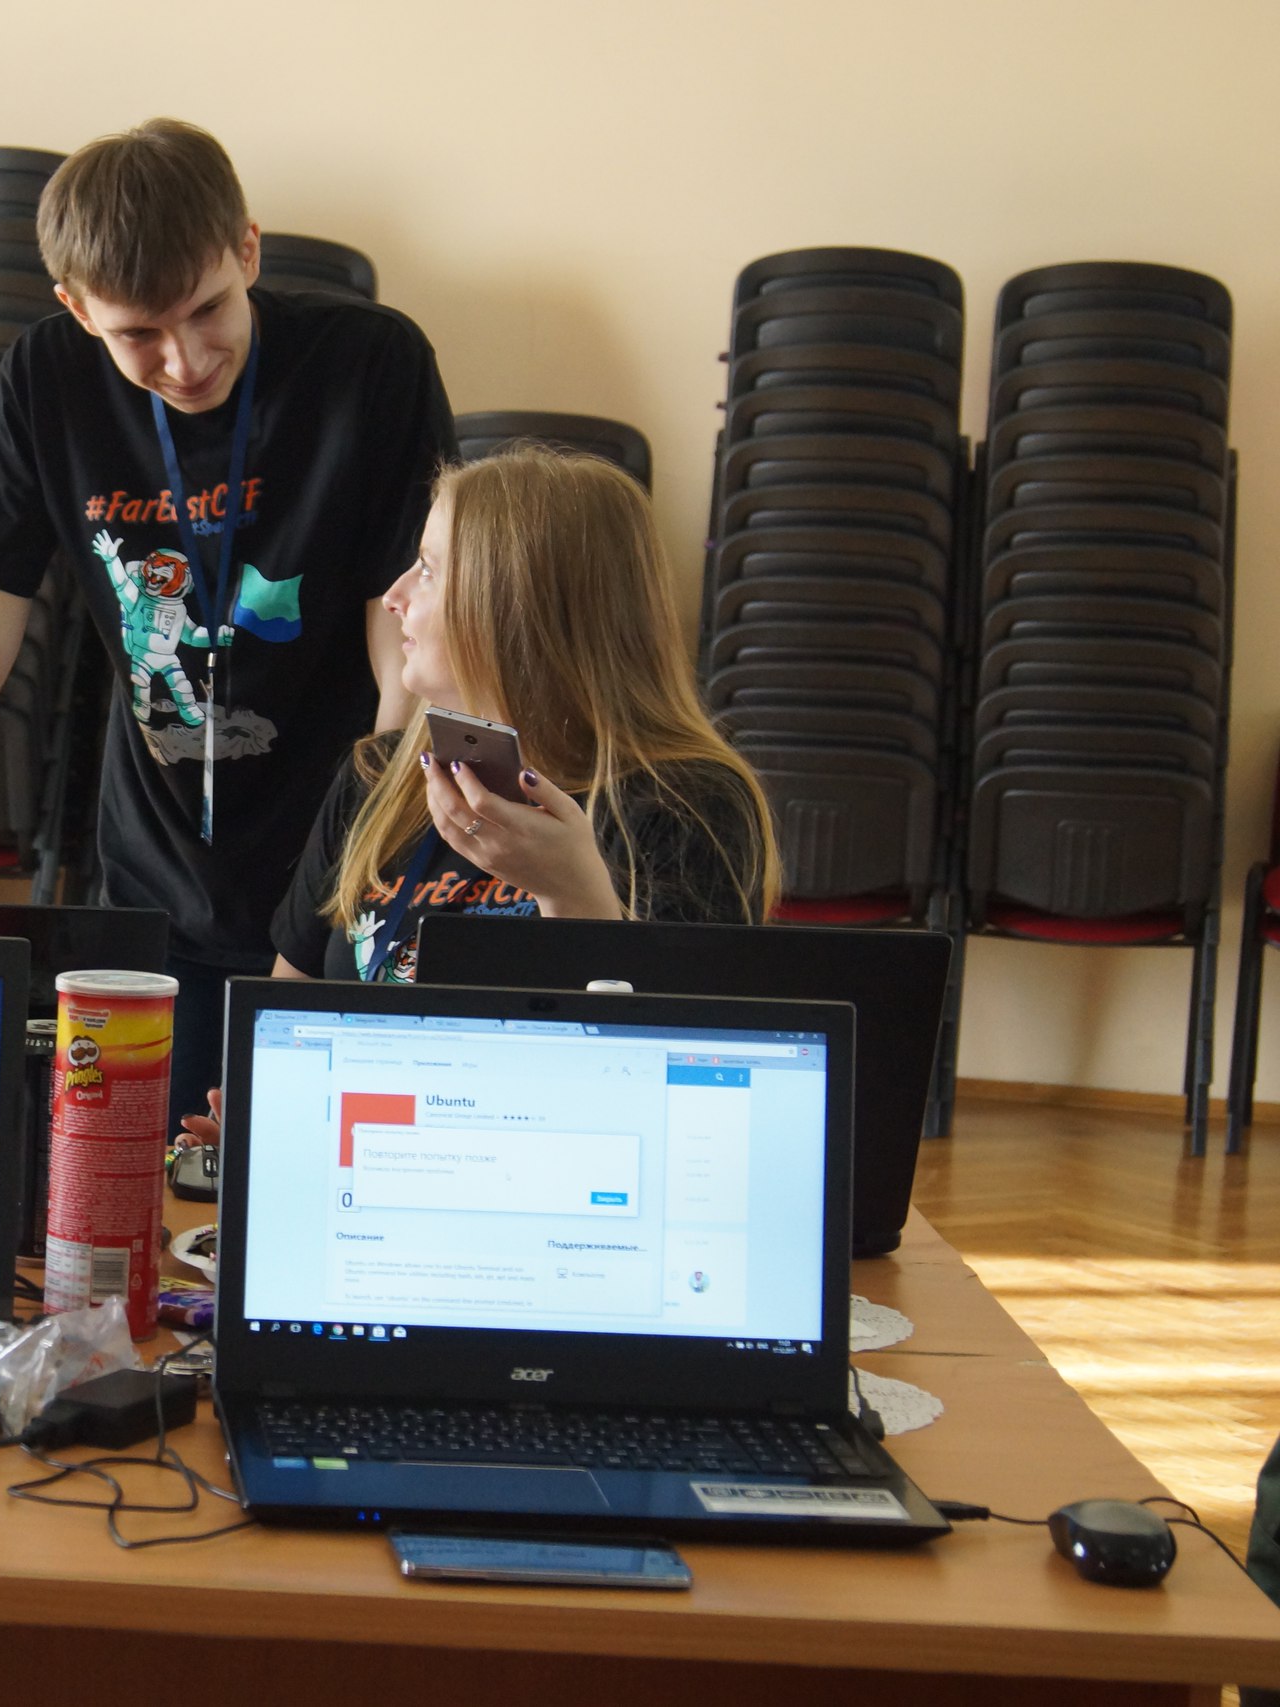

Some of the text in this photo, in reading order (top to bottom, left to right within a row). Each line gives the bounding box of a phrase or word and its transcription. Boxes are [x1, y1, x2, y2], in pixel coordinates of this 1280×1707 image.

[85, 477, 263, 523] #FarEstCF
[64, 1063, 104, 1092] Pringles
[425, 1094, 476, 1107] Ubuntu
[510, 1366, 555, 1382] acer
